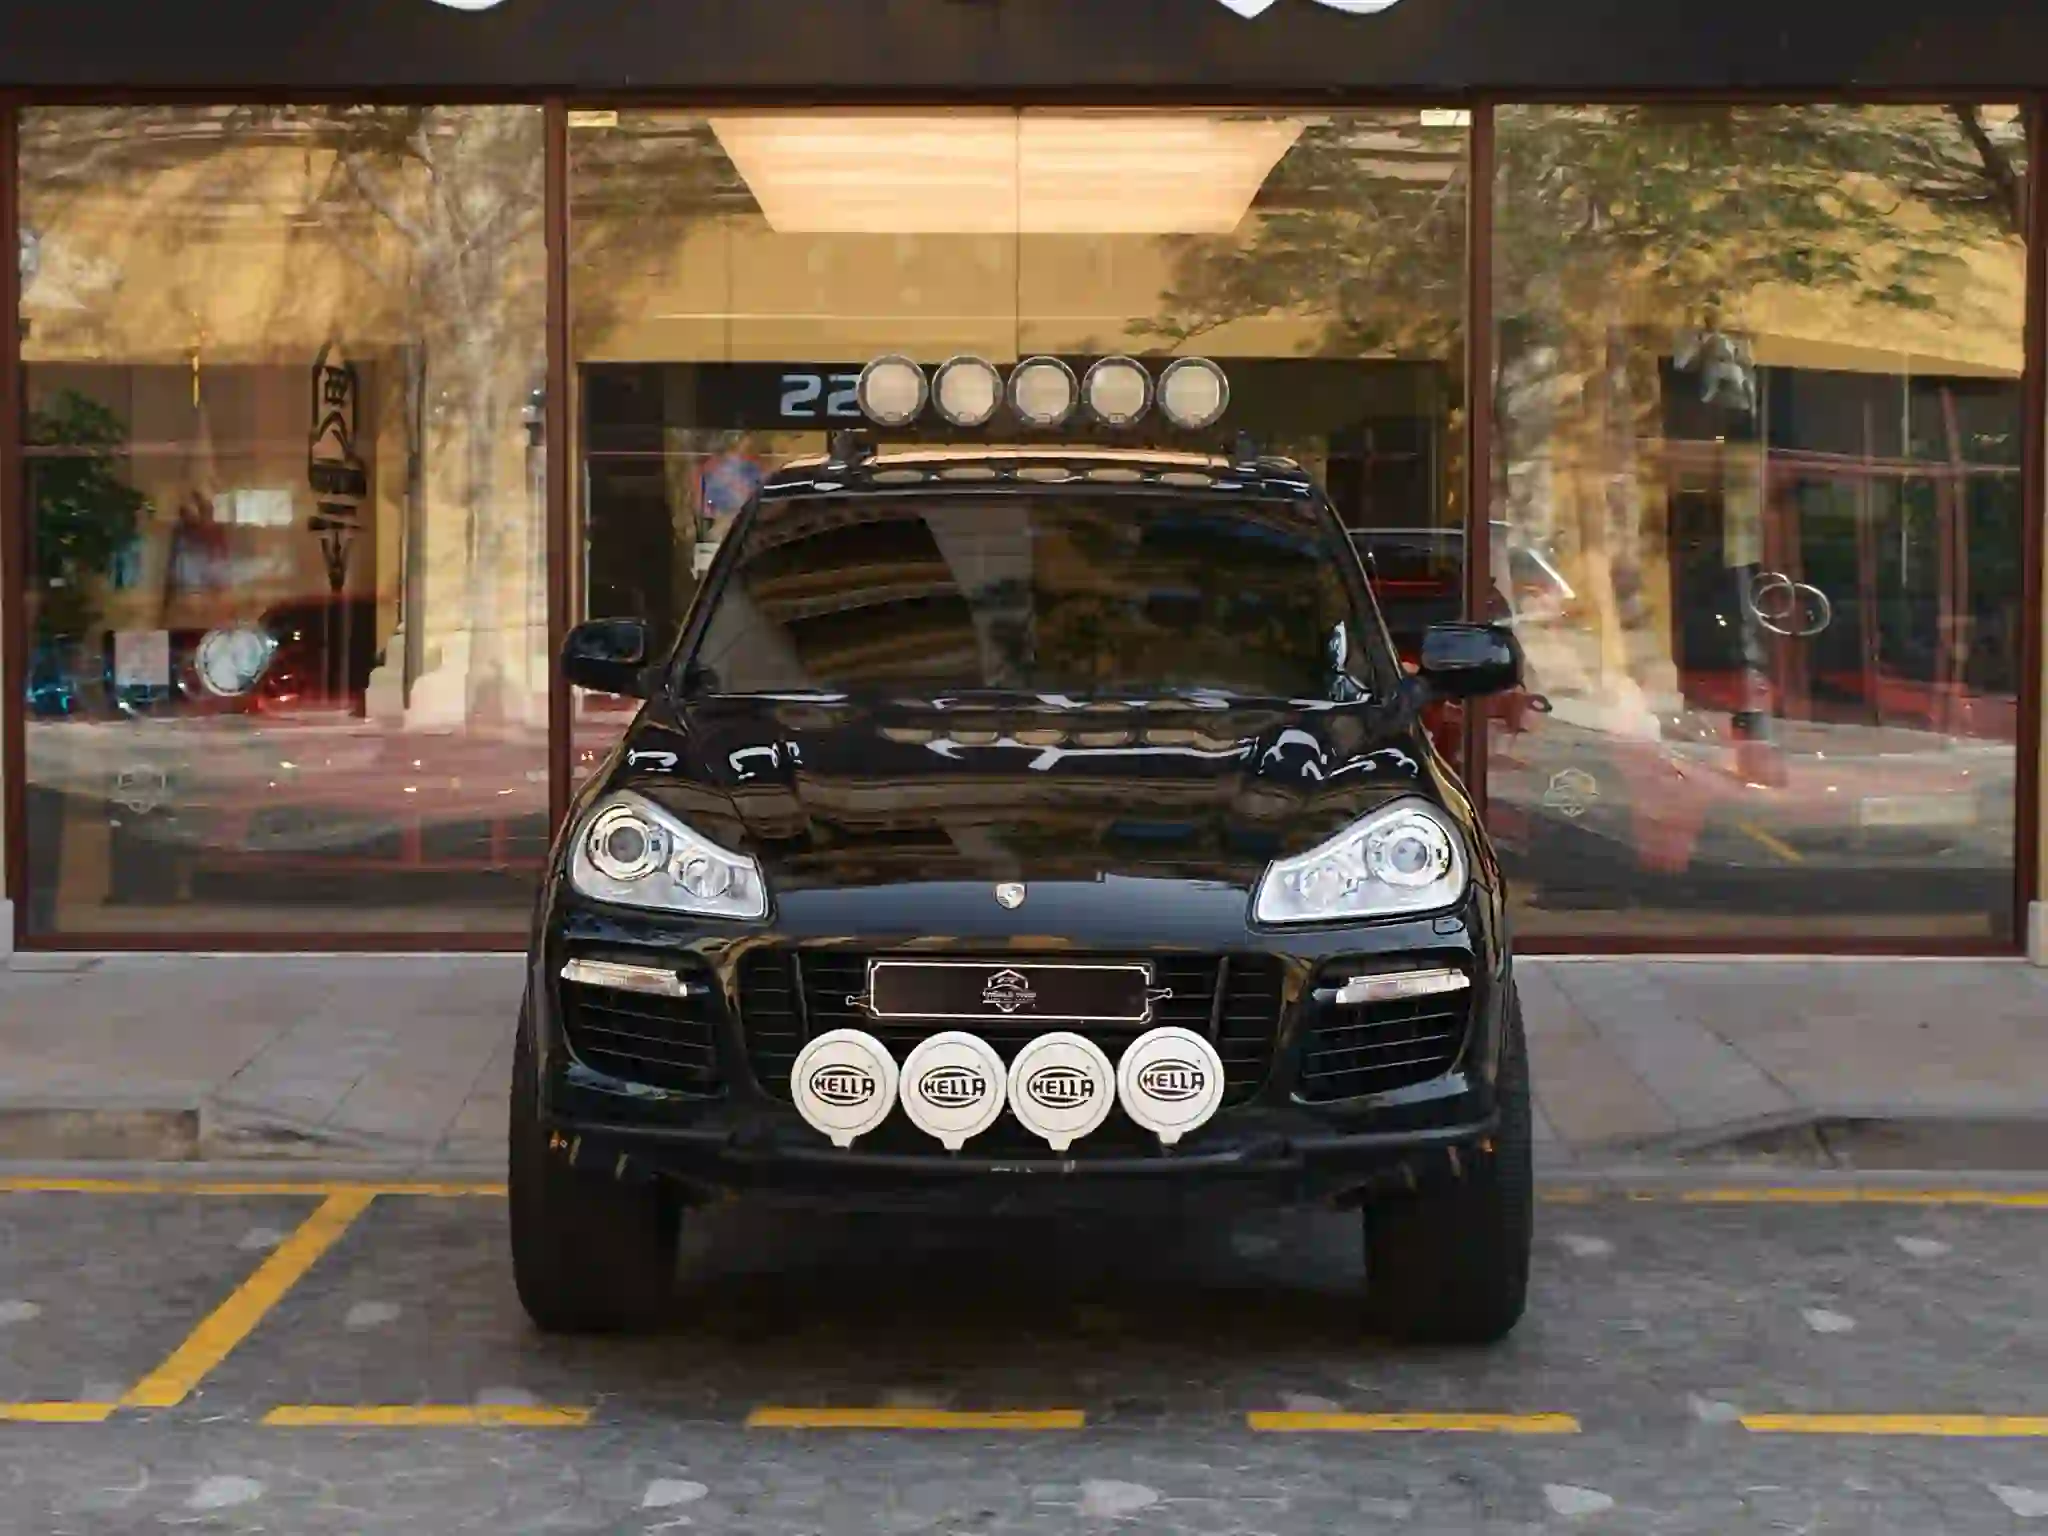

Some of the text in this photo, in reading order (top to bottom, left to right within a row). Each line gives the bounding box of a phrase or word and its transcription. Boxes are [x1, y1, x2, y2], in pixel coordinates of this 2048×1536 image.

[814, 1077, 875, 1097] HELLA
[924, 1078, 986, 1098] HELLA
[1032, 1080, 1095, 1098] HELLA
[1142, 1073, 1205, 1092] HELLA
